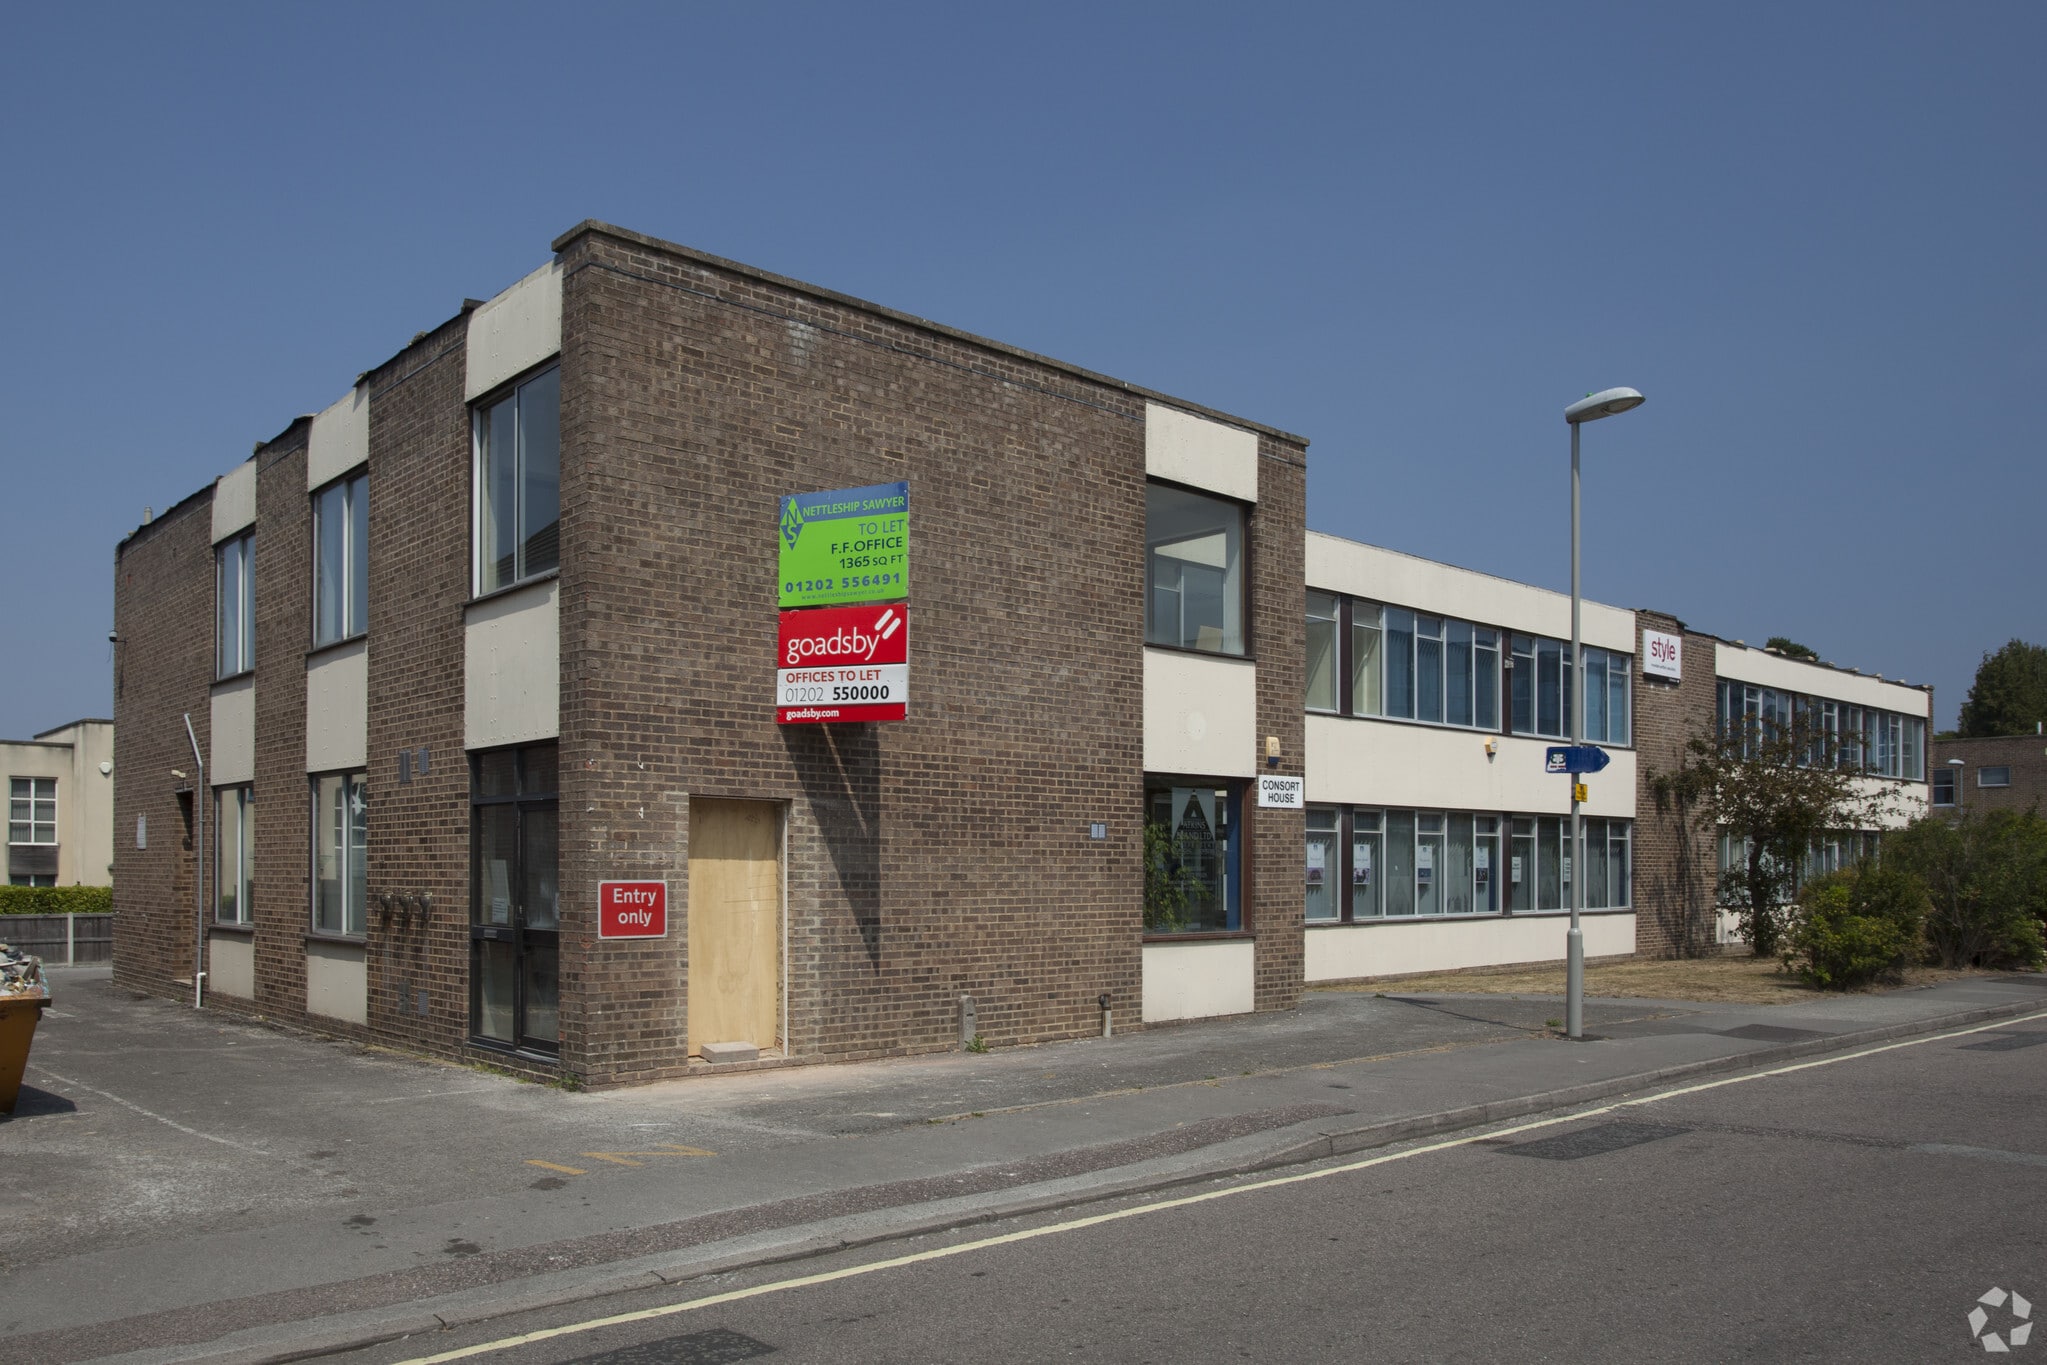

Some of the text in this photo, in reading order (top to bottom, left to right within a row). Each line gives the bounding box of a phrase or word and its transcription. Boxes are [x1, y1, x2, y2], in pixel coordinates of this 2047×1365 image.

[803, 496, 905, 517] NETTLESHIP SAWYER
[858, 519, 905, 536] TO LET
[831, 536, 902, 554] F.F.OFFICE
[840, 554, 904, 569] 1365 SQ FT
[785, 573, 900, 593] 01202 556491
[786, 626, 880, 664] goadsby
[1651, 636, 1676, 662] style
[786, 669, 882, 684] OFFICES TO LET
[785, 685, 890, 702] 01202 550000
[786, 708, 840, 721] goadsby.com
[1262, 780, 1300, 791] CONSORT
[1268, 792, 1295, 803] HOUSE
[613, 888, 657, 907] Entry
[618, 908, 652, 927] only
